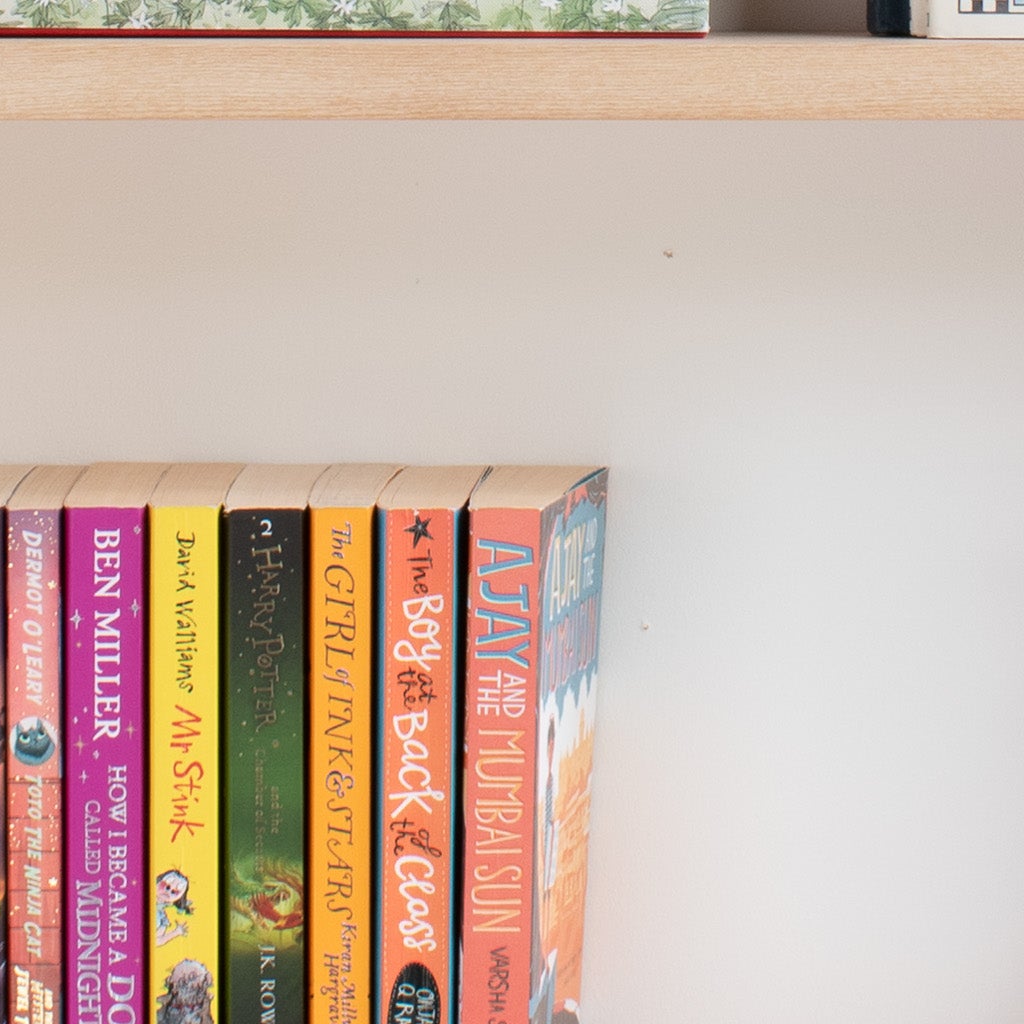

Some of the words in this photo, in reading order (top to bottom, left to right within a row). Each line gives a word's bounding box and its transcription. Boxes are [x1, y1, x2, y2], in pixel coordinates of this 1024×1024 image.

[259, 519, 273, 536] 2
[331, 521, 352, 559] The
[22, 530, 43, 615] DERMOT
[93, 528, 121, 599] BEN
[176, 530, 196, 593] David
[406, 549, 433, 595] The
[249, 544, 283, 635] HARRY
[324, 564, 356, 668] GIRL
[475, 538, 534, 669] AJAY
[175, 599, 198, 694] Walliams
[393, 594, 445, 672] Boy
[22, 619, 43, 706] O'LEARY
[93, 608, 121, 741] MILLER
[251, 634, 285, 733] POTTER
[323, 668, 354, 690] of
[396, 666, 417, 711] the
[417, 671, 438, 705] at
[476, 670, 501, 716] THE
[502, 672, 527, 718] AND
[169, 704, 202, 754] Mr
[25, 774, 43, 820] TOTO
[107, 765, 127, 823] HOW
[169, 761, 205, 843] Stink
[474, 729, 526, 855] MUMBAI
[24, 825, 42, 861] THE
[84, 800, 101, 875] CALLED
[108, 830, 127, 839] I
[389, 817, 414, 856] the
[410, 829, 442, 858] of
[24, 864, 43, 916] NINJA
[107, 845, 128, 943] BECAME
[394, 855, 437, 953] Class
[471, 864, 523, 933] SUN
[23, 921, 43, 958] CAT
[108, 947, 128, 965] A
[341, 921, 357, 974] Kiran
[397, 983, 415, 999] Q
[488, 945, 510, 1013] VARSHA
